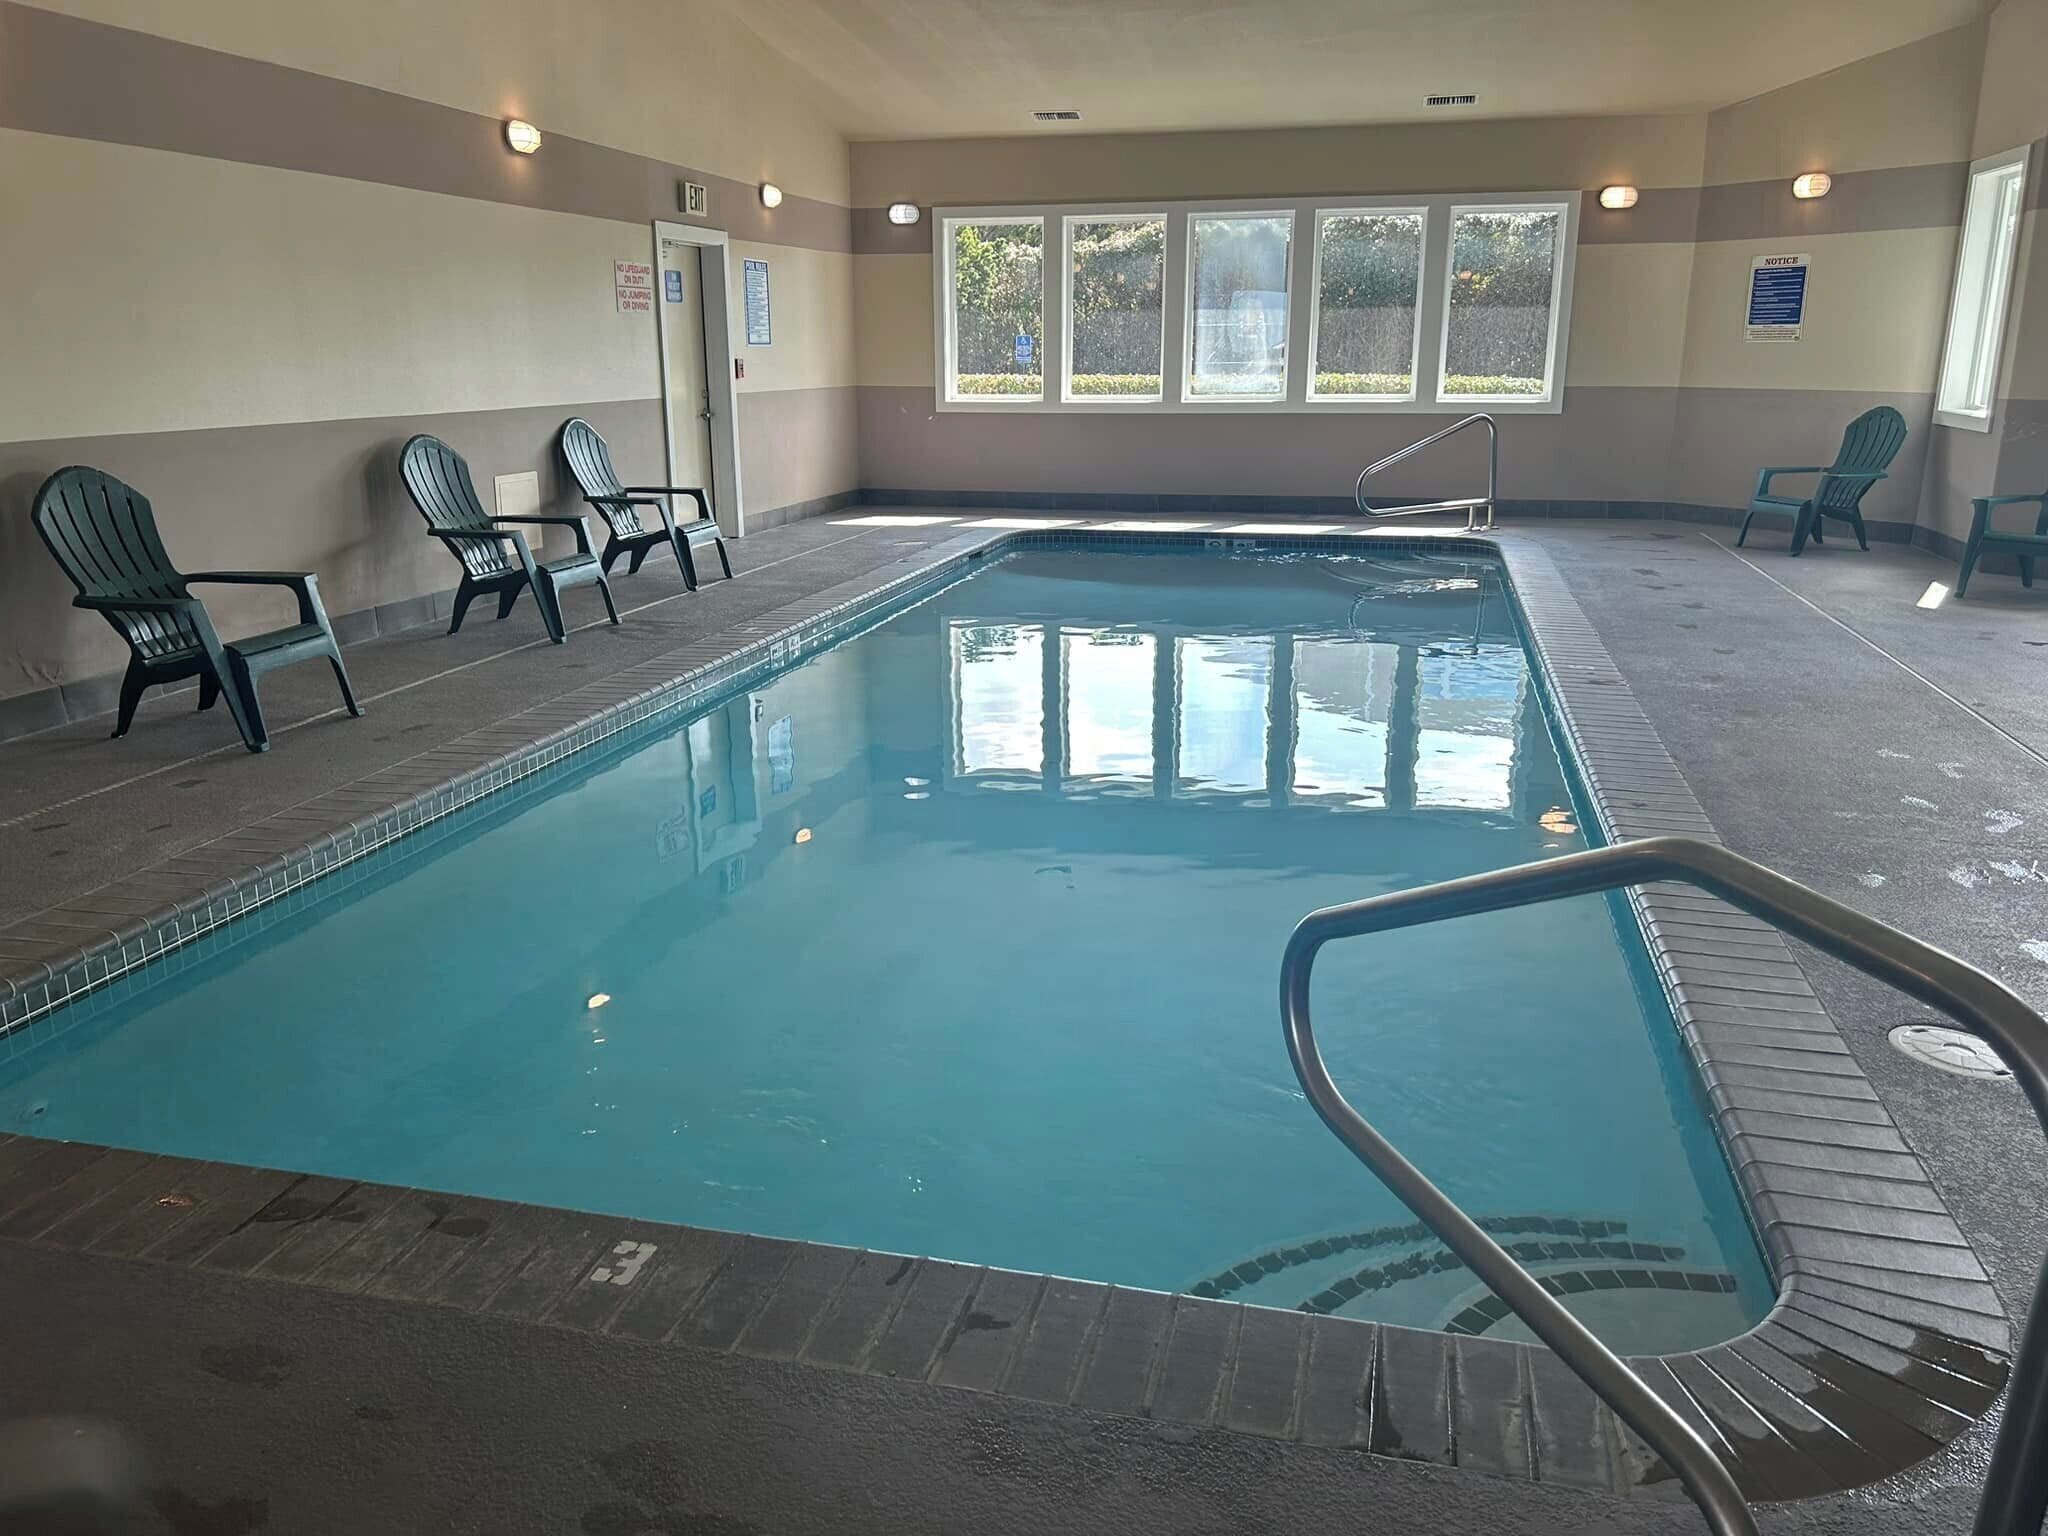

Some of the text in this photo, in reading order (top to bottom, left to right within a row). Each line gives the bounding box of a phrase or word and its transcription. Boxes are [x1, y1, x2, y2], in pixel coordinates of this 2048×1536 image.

[690, 185, 704, 212] EXIT
[1764, 257, 1799, 265] NOTICE
[617, 264, 651, 275] NO LIFEGUARD
[624, 275, 645, 284] ON DUTY
[619, 290, 651, 300] NO JUMPING
[623, 301, 649, 311] OR DIVING
[590, 1240, 658, 1286] 3
